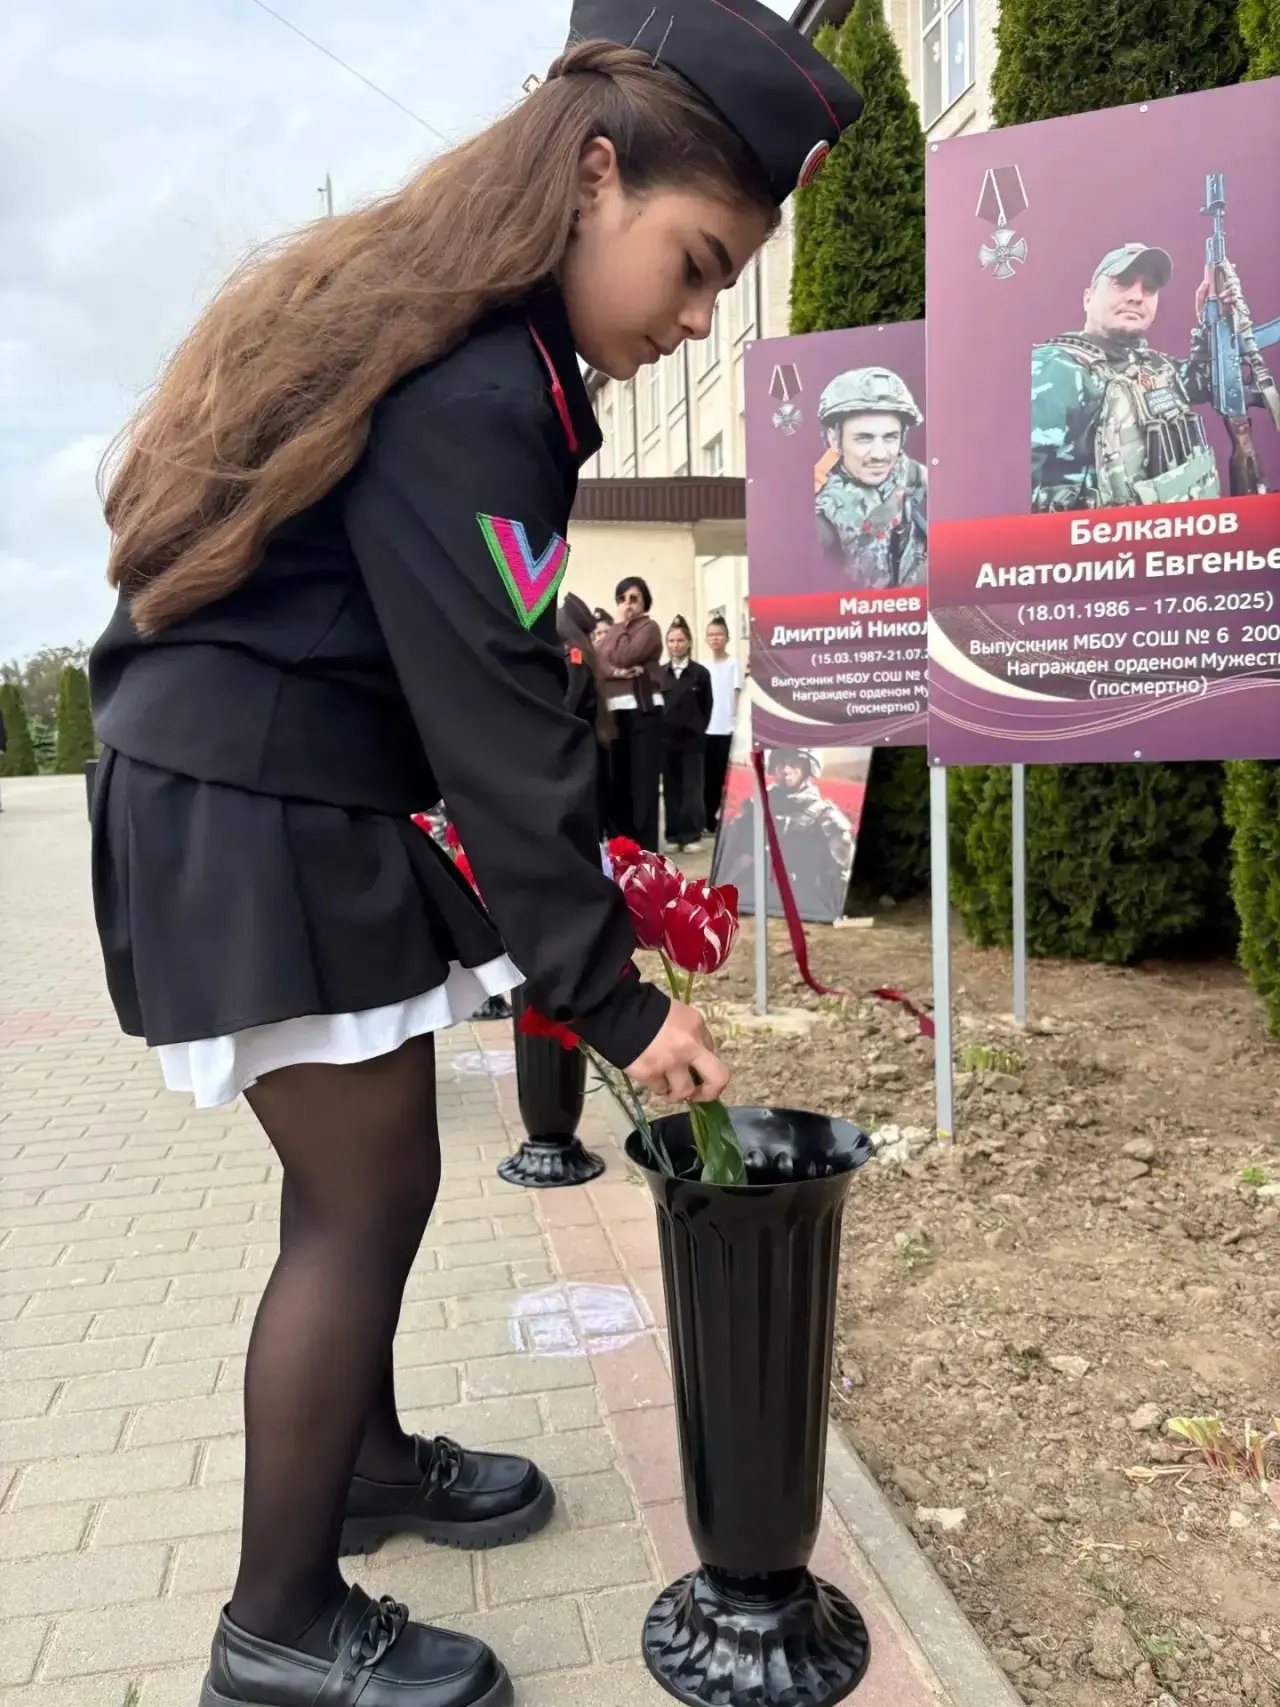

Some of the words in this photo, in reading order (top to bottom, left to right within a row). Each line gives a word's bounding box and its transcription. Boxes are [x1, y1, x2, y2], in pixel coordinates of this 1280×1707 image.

[1070, 512, 1239, 546] Белканов
[975, 552, 1136, 588] Анатолий
[1145, 547, 1280, 577] Евгенье
[839, 596, 921, 616] Малеев
[1018, 600, 1130, 625] (18.01.1986
[1154, 591, 1274, 615] 17.06.2025)
[771, 621, 862, 647] Дмитрий
[970, 638, 1068, 656] Выпускник
[1073, 632, 1127, 650] МБОУ
[1132, 630, 1179, 647] СОШ
[1185, 628, 1210, 645] №
[1217, 627, 1229, 643] 6
[1241, 624, 1280, 642] 200
[771, 675, 834, 688] Выпускник
[836, 672, 870, 685] МБОУ
[872, 671, 903, 683] СОШ
[905, 669, 921, 681] №
[1007, 658, 1109, 678] Награжден
[1114, 655, 1197, 674] орденом
[792, 689, 857, 703] Награжден
[859, 687, 911, 701] орденом
[1089, 675, 1208, 699] (посмертно)
[846, 700, 921, 716] (посмертно)
